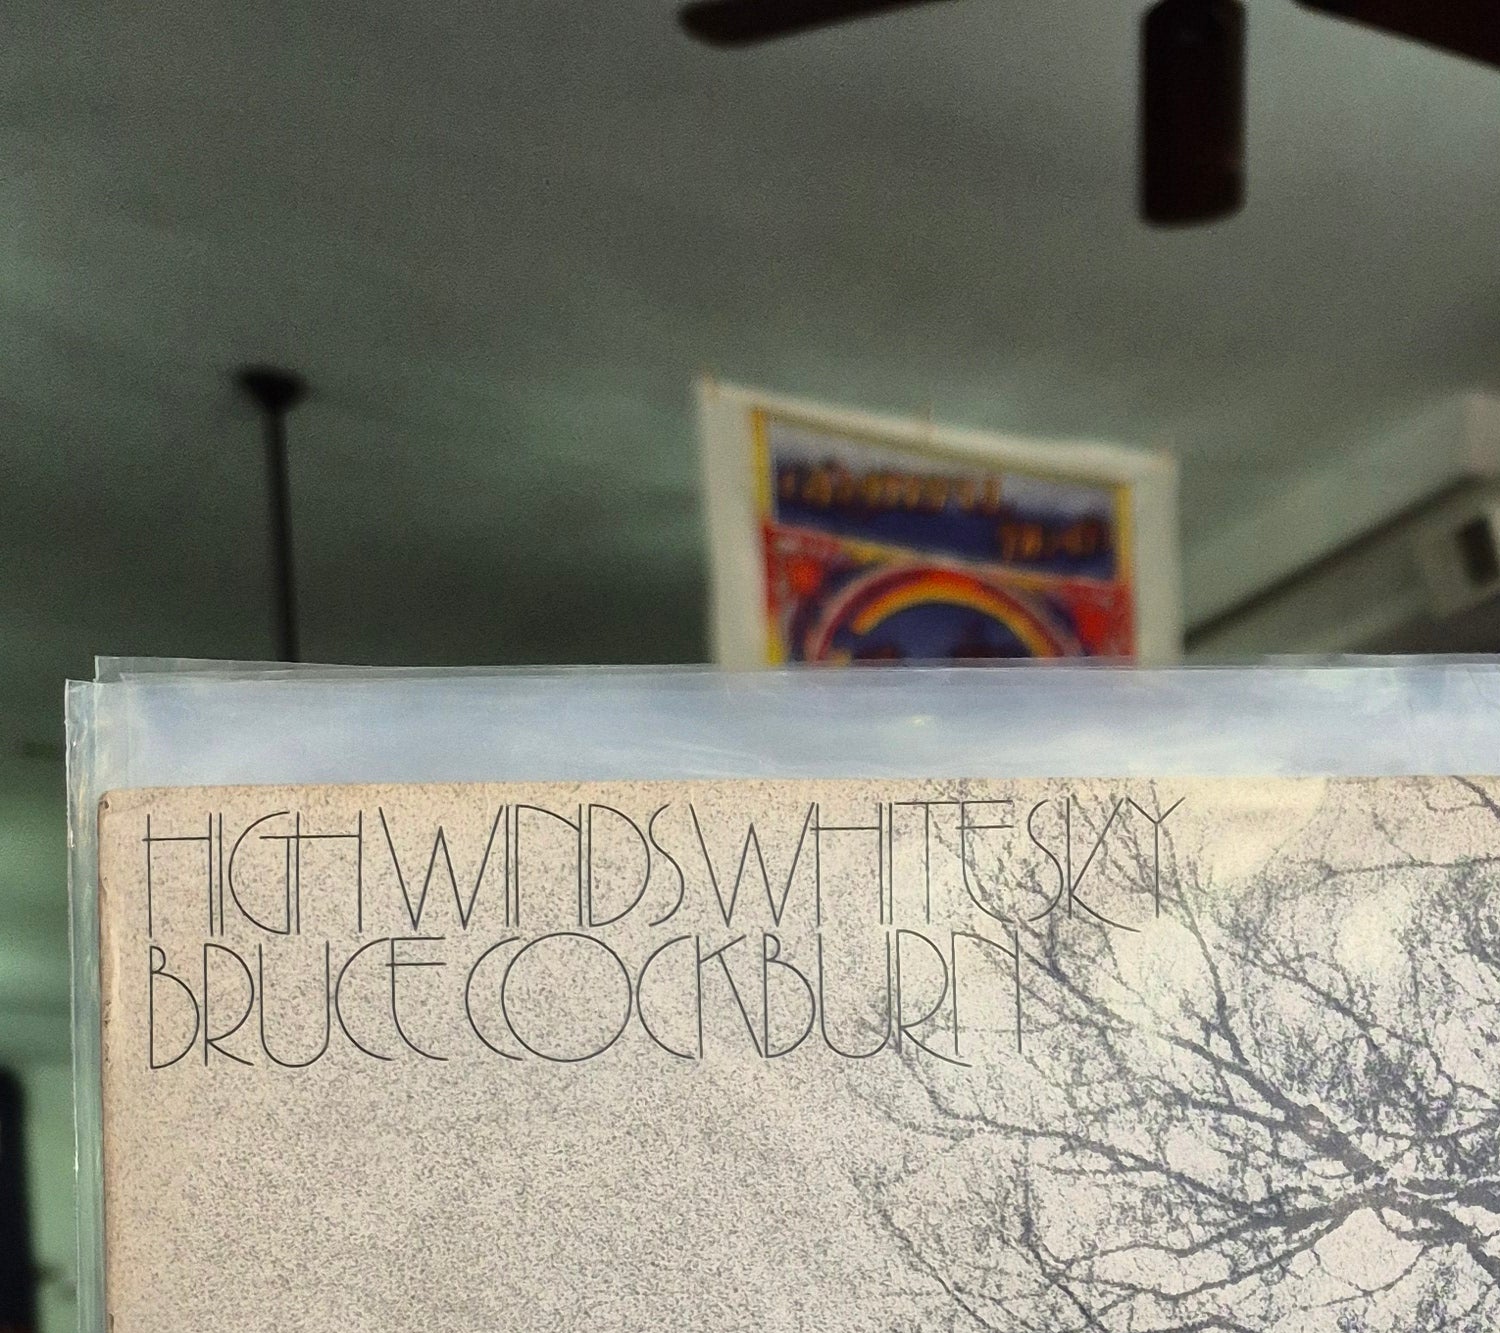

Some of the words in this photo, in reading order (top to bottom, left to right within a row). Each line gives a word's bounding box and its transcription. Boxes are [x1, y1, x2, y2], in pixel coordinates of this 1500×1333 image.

[143, 810, 363, 938] HIGH
[379, 803, 684, 930] WINDS
[689, 799, 1014, 927] WHITE
[1027, 796, 1186, 933] SKY
[149, 936, 448, 1070] BRUCE
[465, 929, 1021, 1068] COCKBURN
